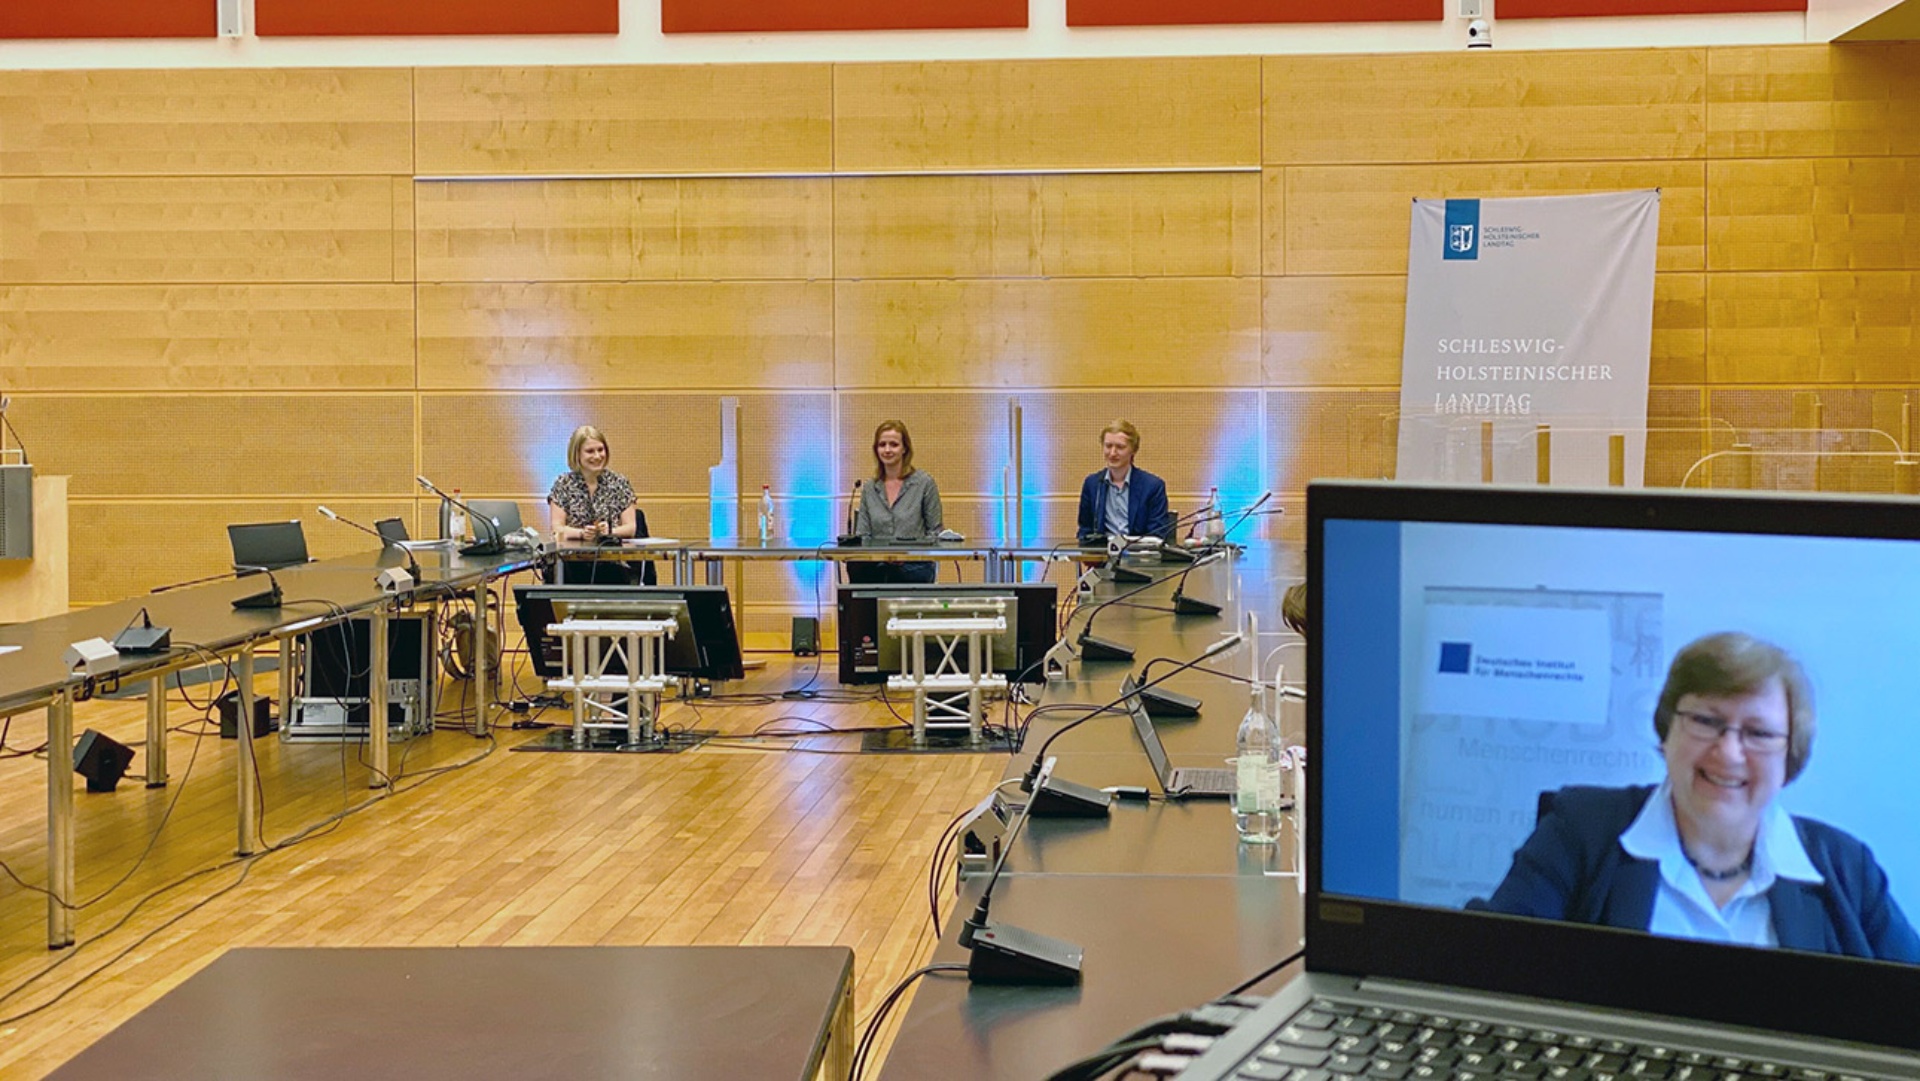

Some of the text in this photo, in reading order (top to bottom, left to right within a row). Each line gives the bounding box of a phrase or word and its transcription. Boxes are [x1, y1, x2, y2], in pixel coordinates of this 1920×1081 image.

[1483, 240, 1515, 248] LANDTAG
[1438, 338, 1565, 354] SCHLESWIG-
[1436, 364, 1613, 381] HOLSTEINISCHER
[1434, 392, 1532, 413] LANDTAG
[1476, 655, 1576, 670] Deutsches Institut
[1494, 669, 1584, 682] Menschenrechte
